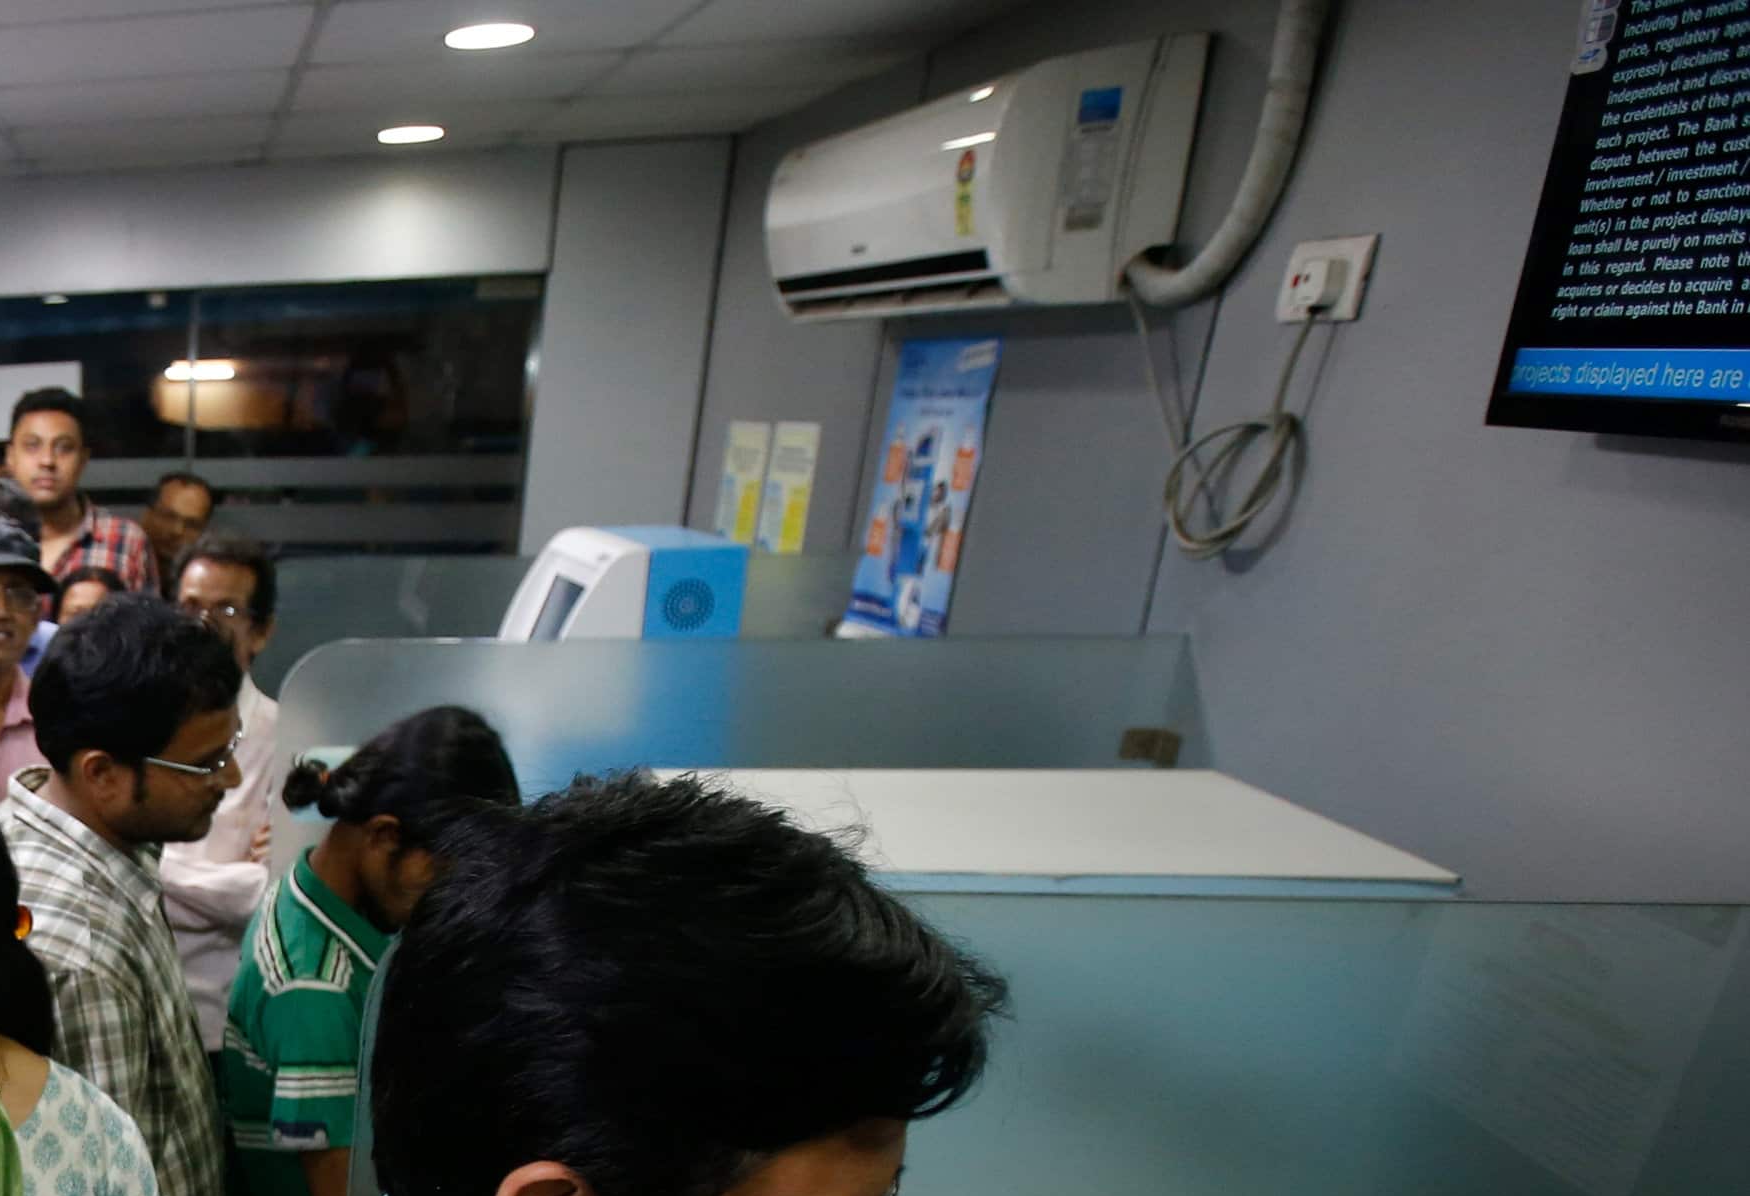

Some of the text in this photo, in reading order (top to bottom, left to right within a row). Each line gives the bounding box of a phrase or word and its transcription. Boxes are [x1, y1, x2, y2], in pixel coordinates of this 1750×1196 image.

[1624, 1, 1748, 38] including the merits
[1618, 20, 1750, 63] price, regulatory app
[1612, 60, 1669, 83] expressly
[1671, 48, 1730, 71] disclaims
[1607, 79, 1680, 104] independent
[1682, 72, 1707, 88] and
[1602, 113, 1620, 127] the
[1623, 98, 1688, 123] credentials
[1691, 95, 1707, 111] of
[1708, 93, 1728, 109] the
[1595, 133, 1621, 149] such
[1625, 125, 1670, 147] project.
[1677, 121, 1699, 136] The
[1704, 114, 1738, 132] Bank
[1590, 154, 1632, 171] dispute
[1637, 146, 1689, 164] between
[1695, 140, 1716, 156] the
[1584, 170, 1654, 192] involvement
[1667, 160, 1739, 182] investment
[1580, 196, 1627, 213] Whether
[1631, 195, 1646, 207] or
[1650, 190, 1671, 206] not
[1677, 189, 1689, 203] to
[1573, 217, 1612, 236] unit(s)
[1614, 217, 1626, 231] in
[1630, 215, 1650, 230] the
[1652, 210, 1697, 231] project
[1567, 229, 1747, 256] loan shall be purely on merits
[1562, 262, 1574, 276] in
[1578, 260, 1601, 275] this
[1605, 258, 1646, 277] regard.
[1653, 255, 1694, 272] Please
[1700, 253, 1731, 269] note
[1556, 282, 1602, 299] acquires
[1605, 284, 1619, 296] or
[1620, 279, 1665, 295] decides
[1668, 279, 1682, 293] to
[1684, 277, 1733, 295] acquire
[1551, 298, 1744, 321] right or claim against the Bank in
[1575, 361, 1659, 391] displayed
[1660, 361, 1705, 388] here
[1709, 367, 1743, 389] are
